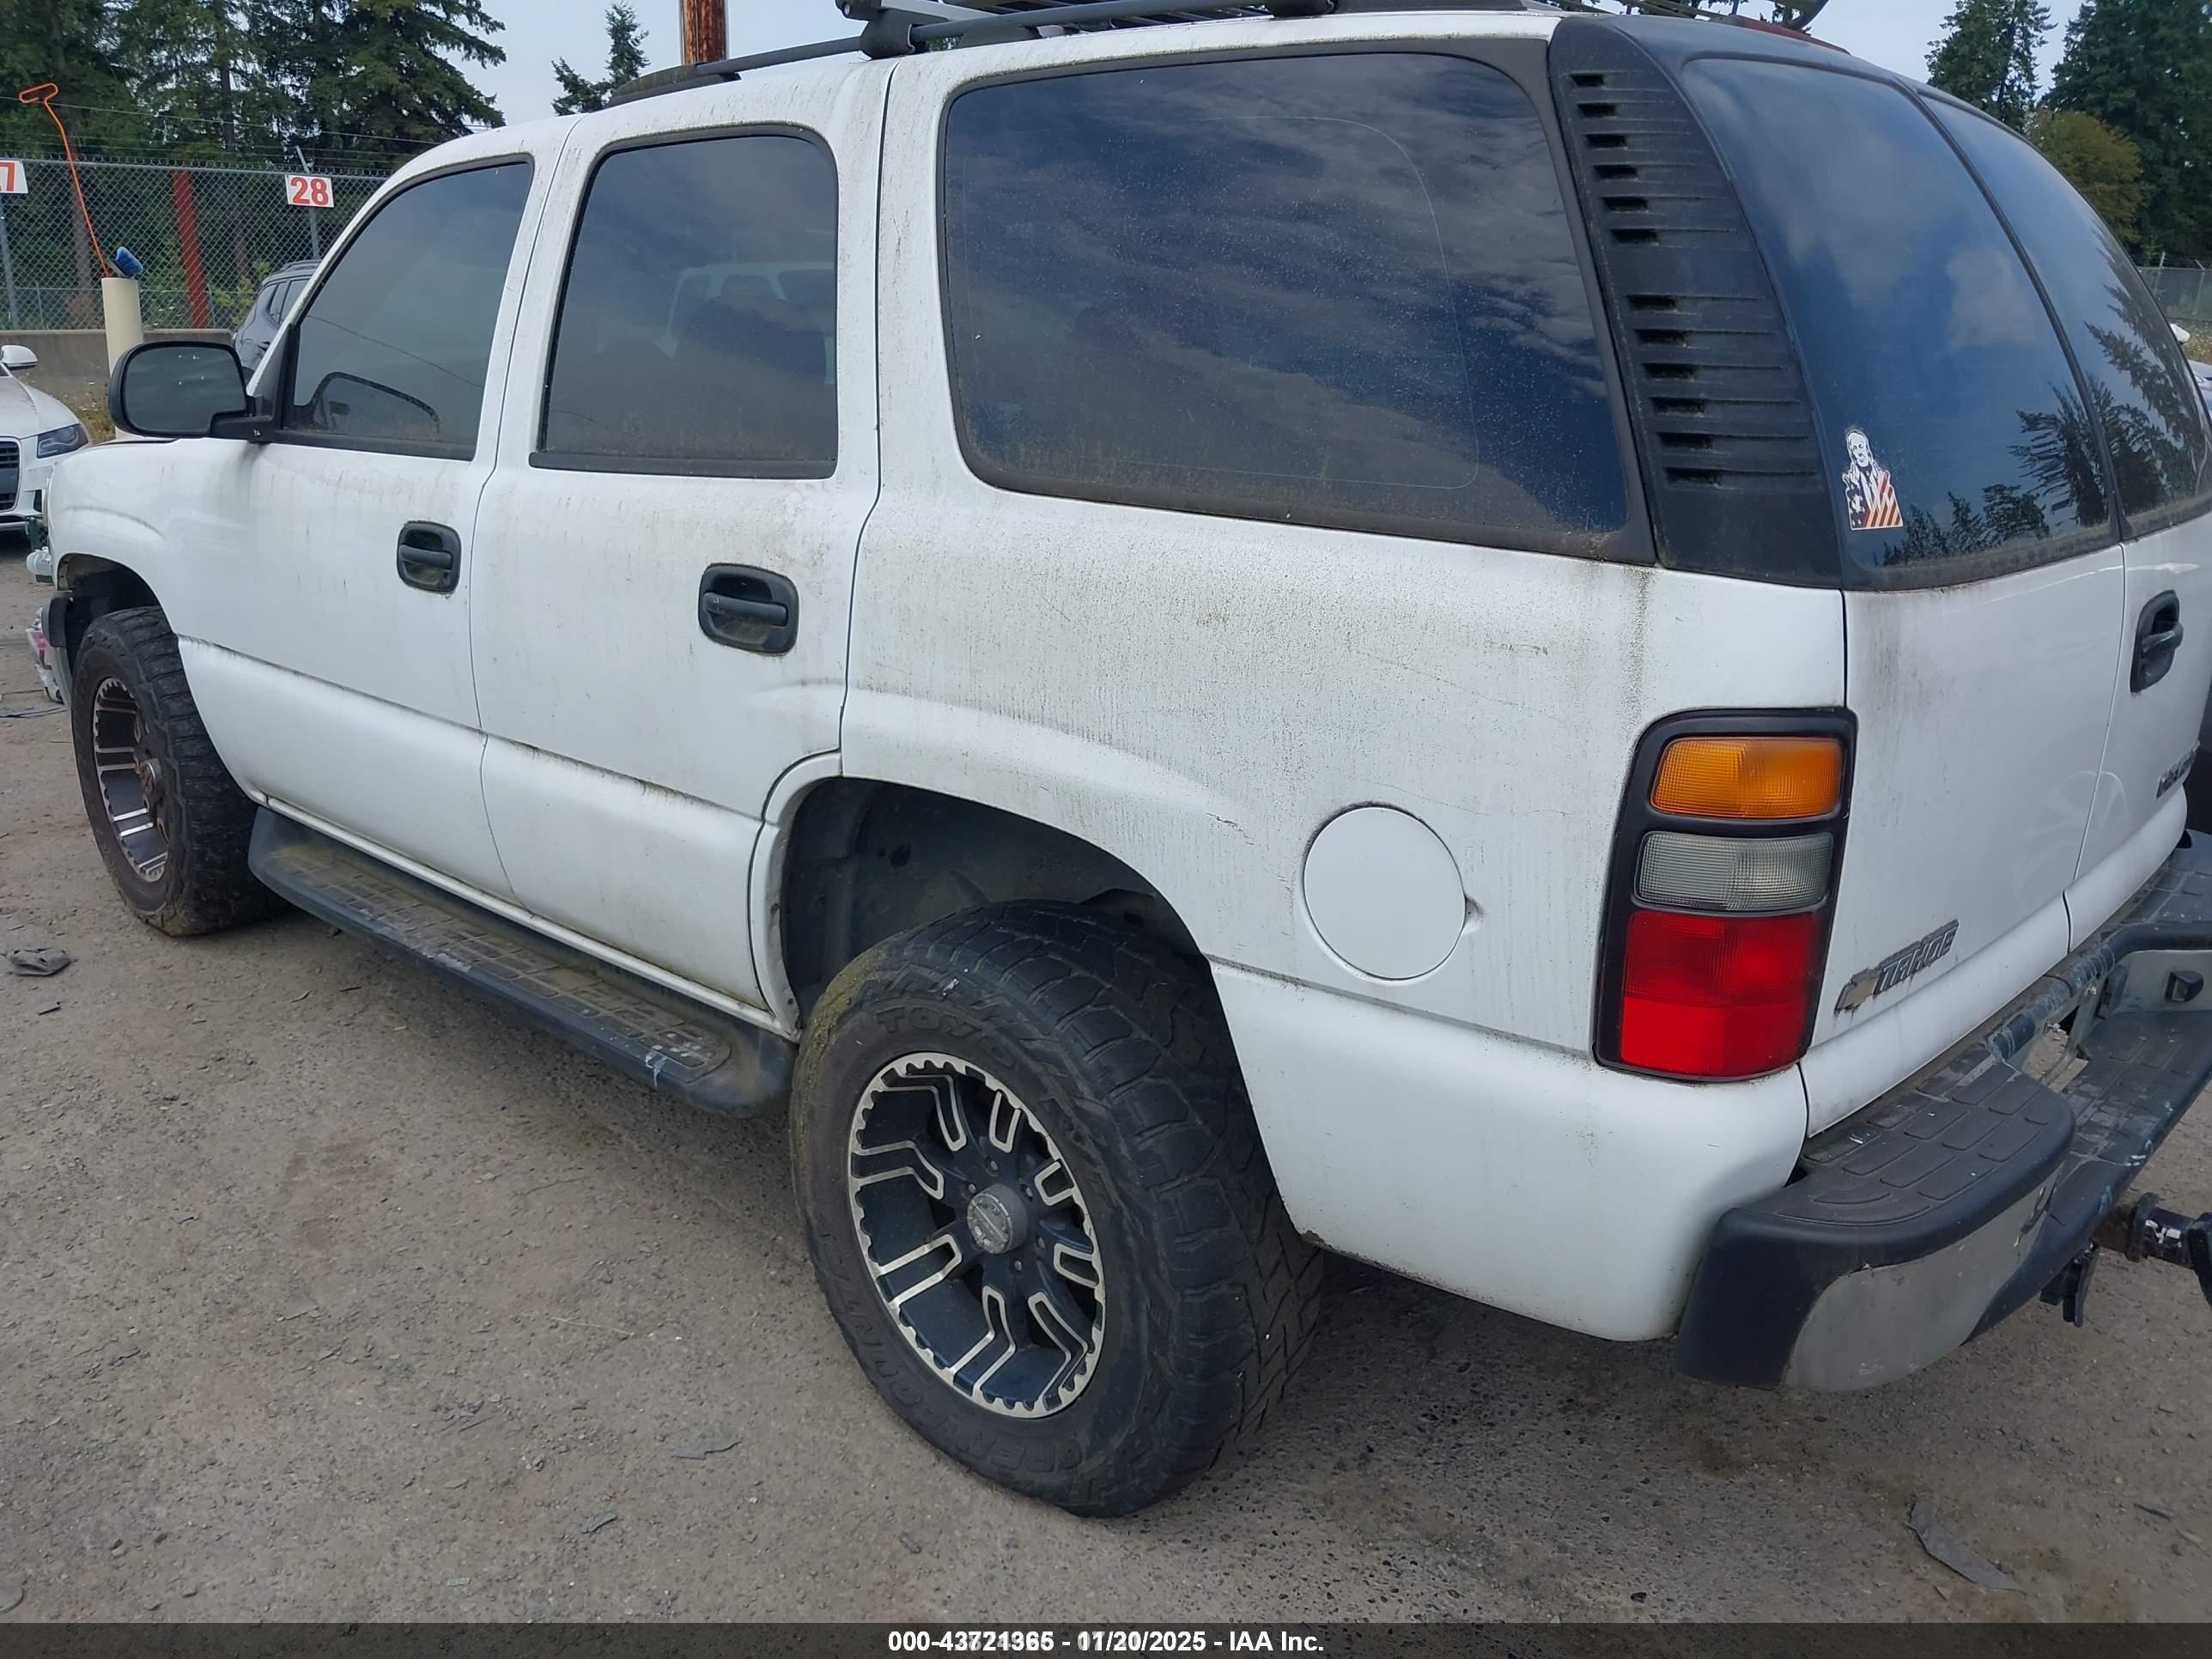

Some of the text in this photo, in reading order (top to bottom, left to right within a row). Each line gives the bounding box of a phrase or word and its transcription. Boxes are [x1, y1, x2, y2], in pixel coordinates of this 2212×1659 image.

[0, 161, 15, 191] 7
[290, 176, 330, 206] 28
[1875, 921, 1959, 994] TAHOE
[875, 1004, 1018, 1070] TOYO
